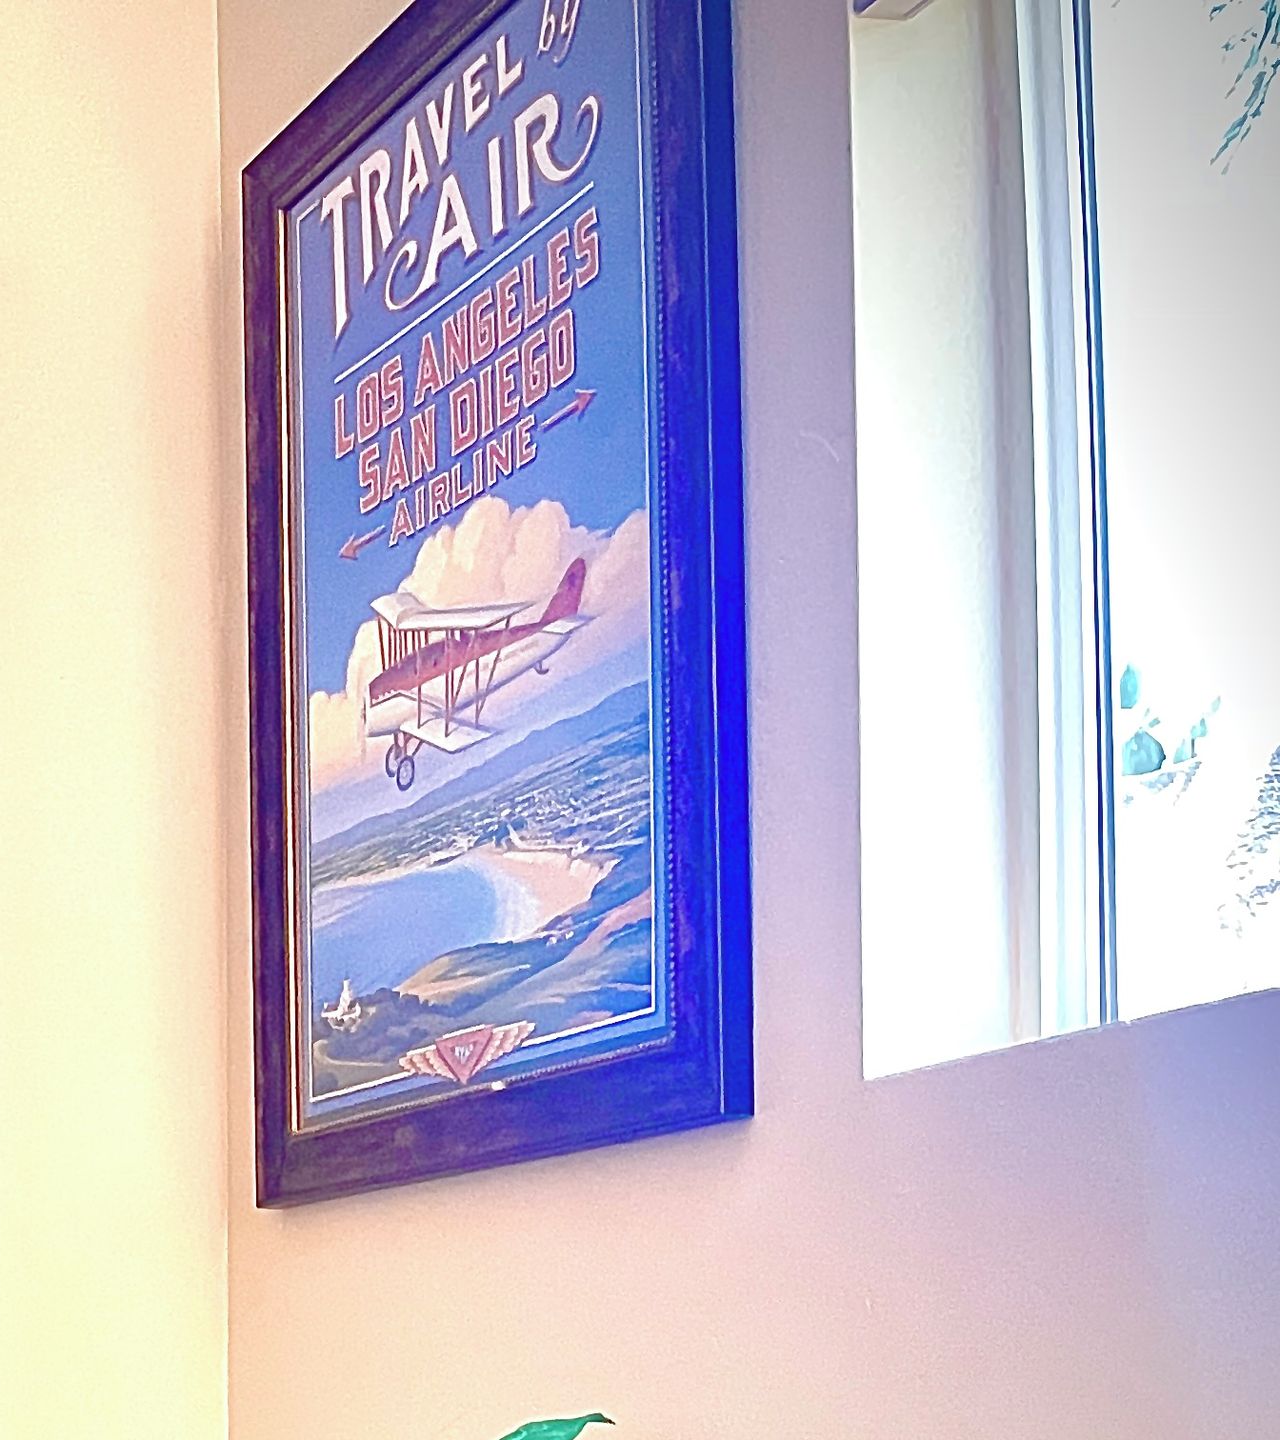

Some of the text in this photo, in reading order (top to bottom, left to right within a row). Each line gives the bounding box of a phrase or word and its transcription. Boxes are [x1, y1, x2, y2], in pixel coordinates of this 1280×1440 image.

[321, 0, 581, 339] TRAVEL by
[386, 92, 600, 311] AIR
[334, 207, 601, 460] LOS ANGELES
[358, 308, 577, 515] SAN DIEGO
[388, 413, 538, 548] AIRLINE
